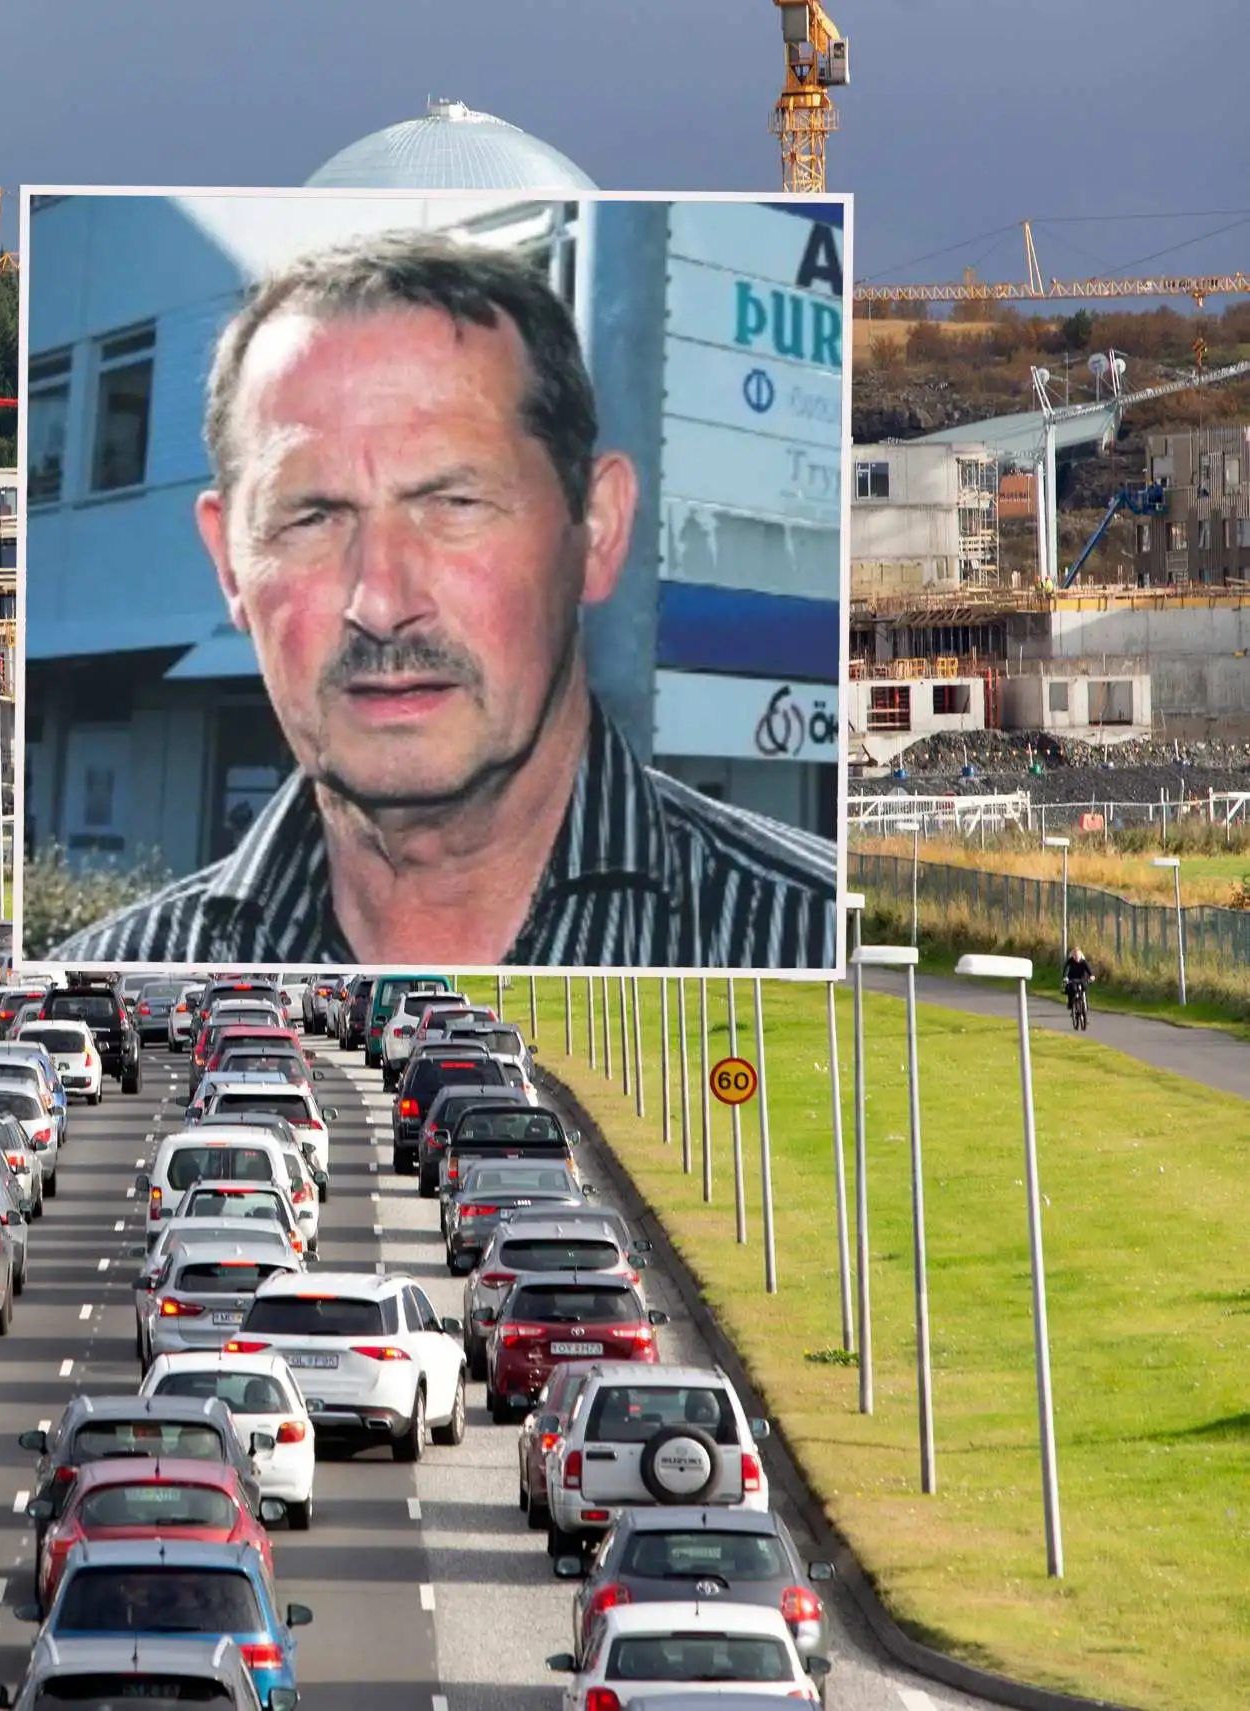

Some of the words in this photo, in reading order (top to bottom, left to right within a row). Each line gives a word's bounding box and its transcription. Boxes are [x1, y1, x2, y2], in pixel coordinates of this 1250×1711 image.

[796, 221, 843, 297] A
[718, 1071, 749, 1090] 60
[661, 1457, 702, 1465] SUZUKI
